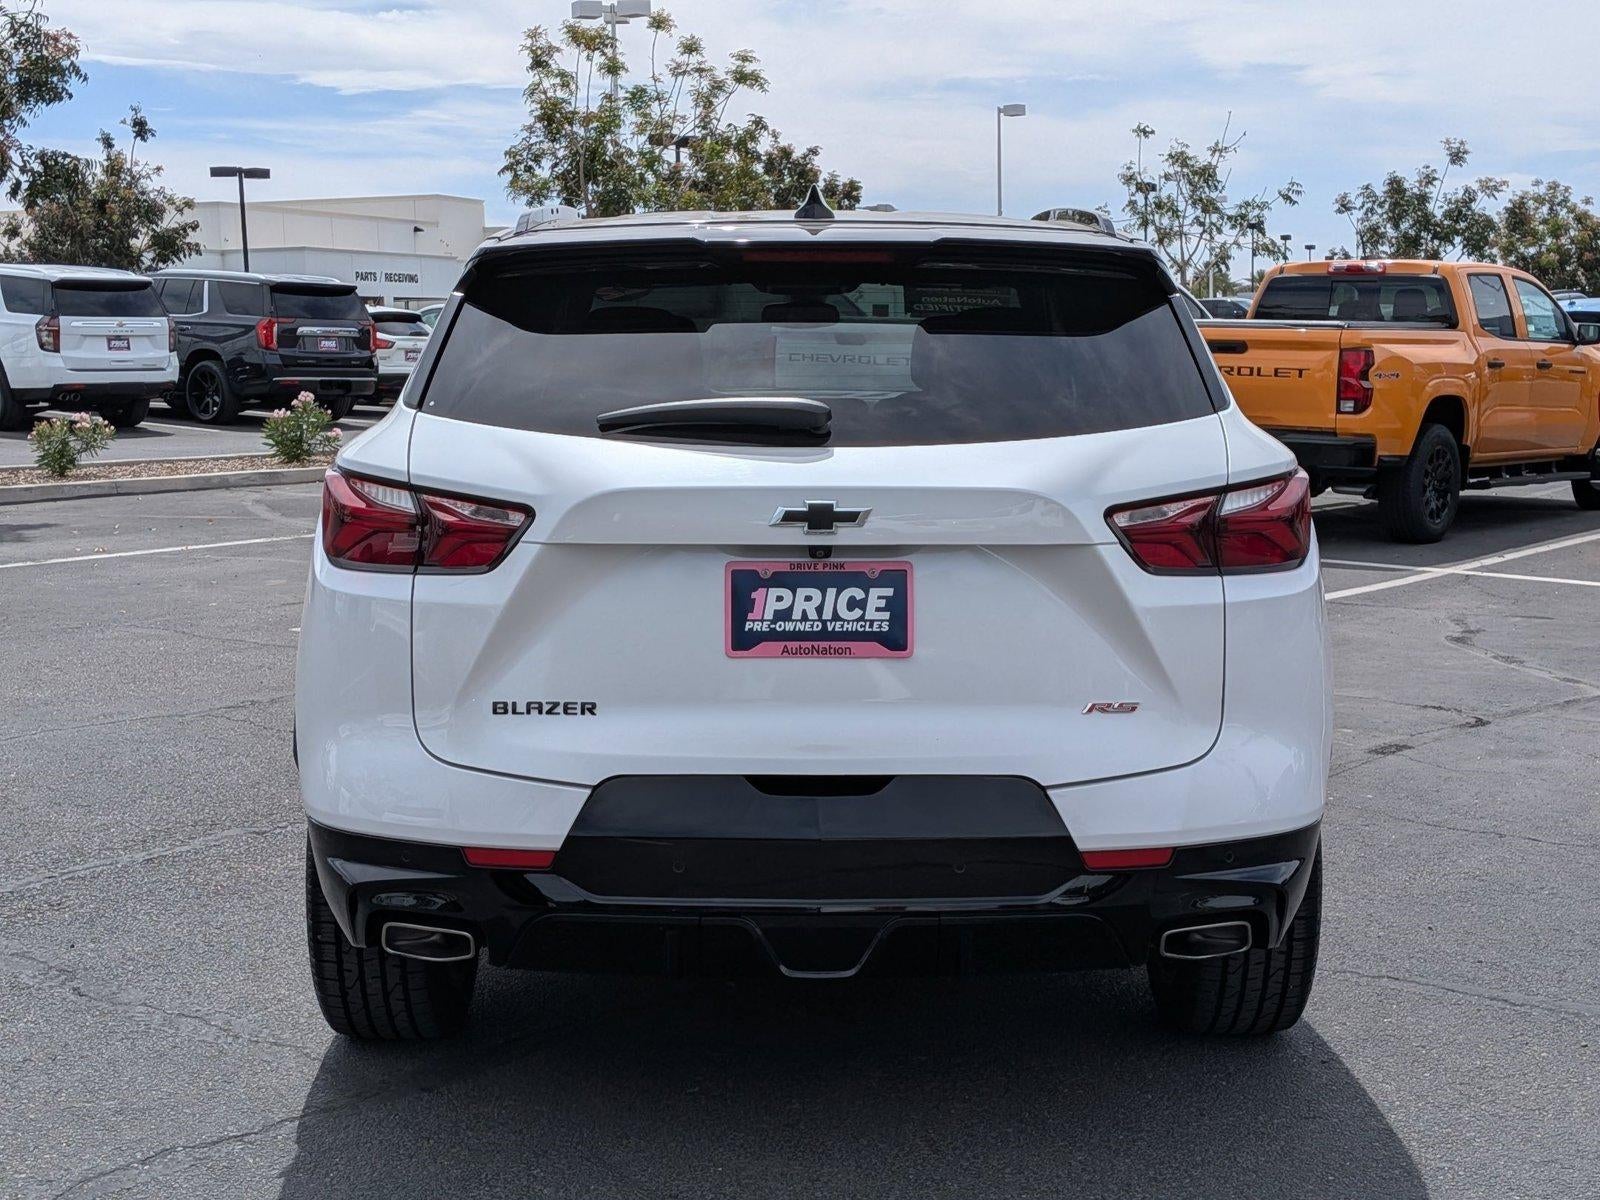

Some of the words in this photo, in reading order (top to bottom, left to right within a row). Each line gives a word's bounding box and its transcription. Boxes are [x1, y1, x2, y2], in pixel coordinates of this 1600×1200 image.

[355, 271, 378, 282] PARTS
[384, 273, 419, 283] RECEIVING
[1218, 366, 1310, 379] ROLET
[789, 562, 820, 571] DRIVE
[822, 562, 846, 571] PINK
[747, 587, 895, 620] 1PRICE
[744, 621, 822, 632] PRE-OWNED
[826, 621, 890, 632] VEHICLES
[780, 644, 852, 656] AutoNation
[492, 701, 597, 716] BLAZER
[1081, 702, 1139, 714] RS
